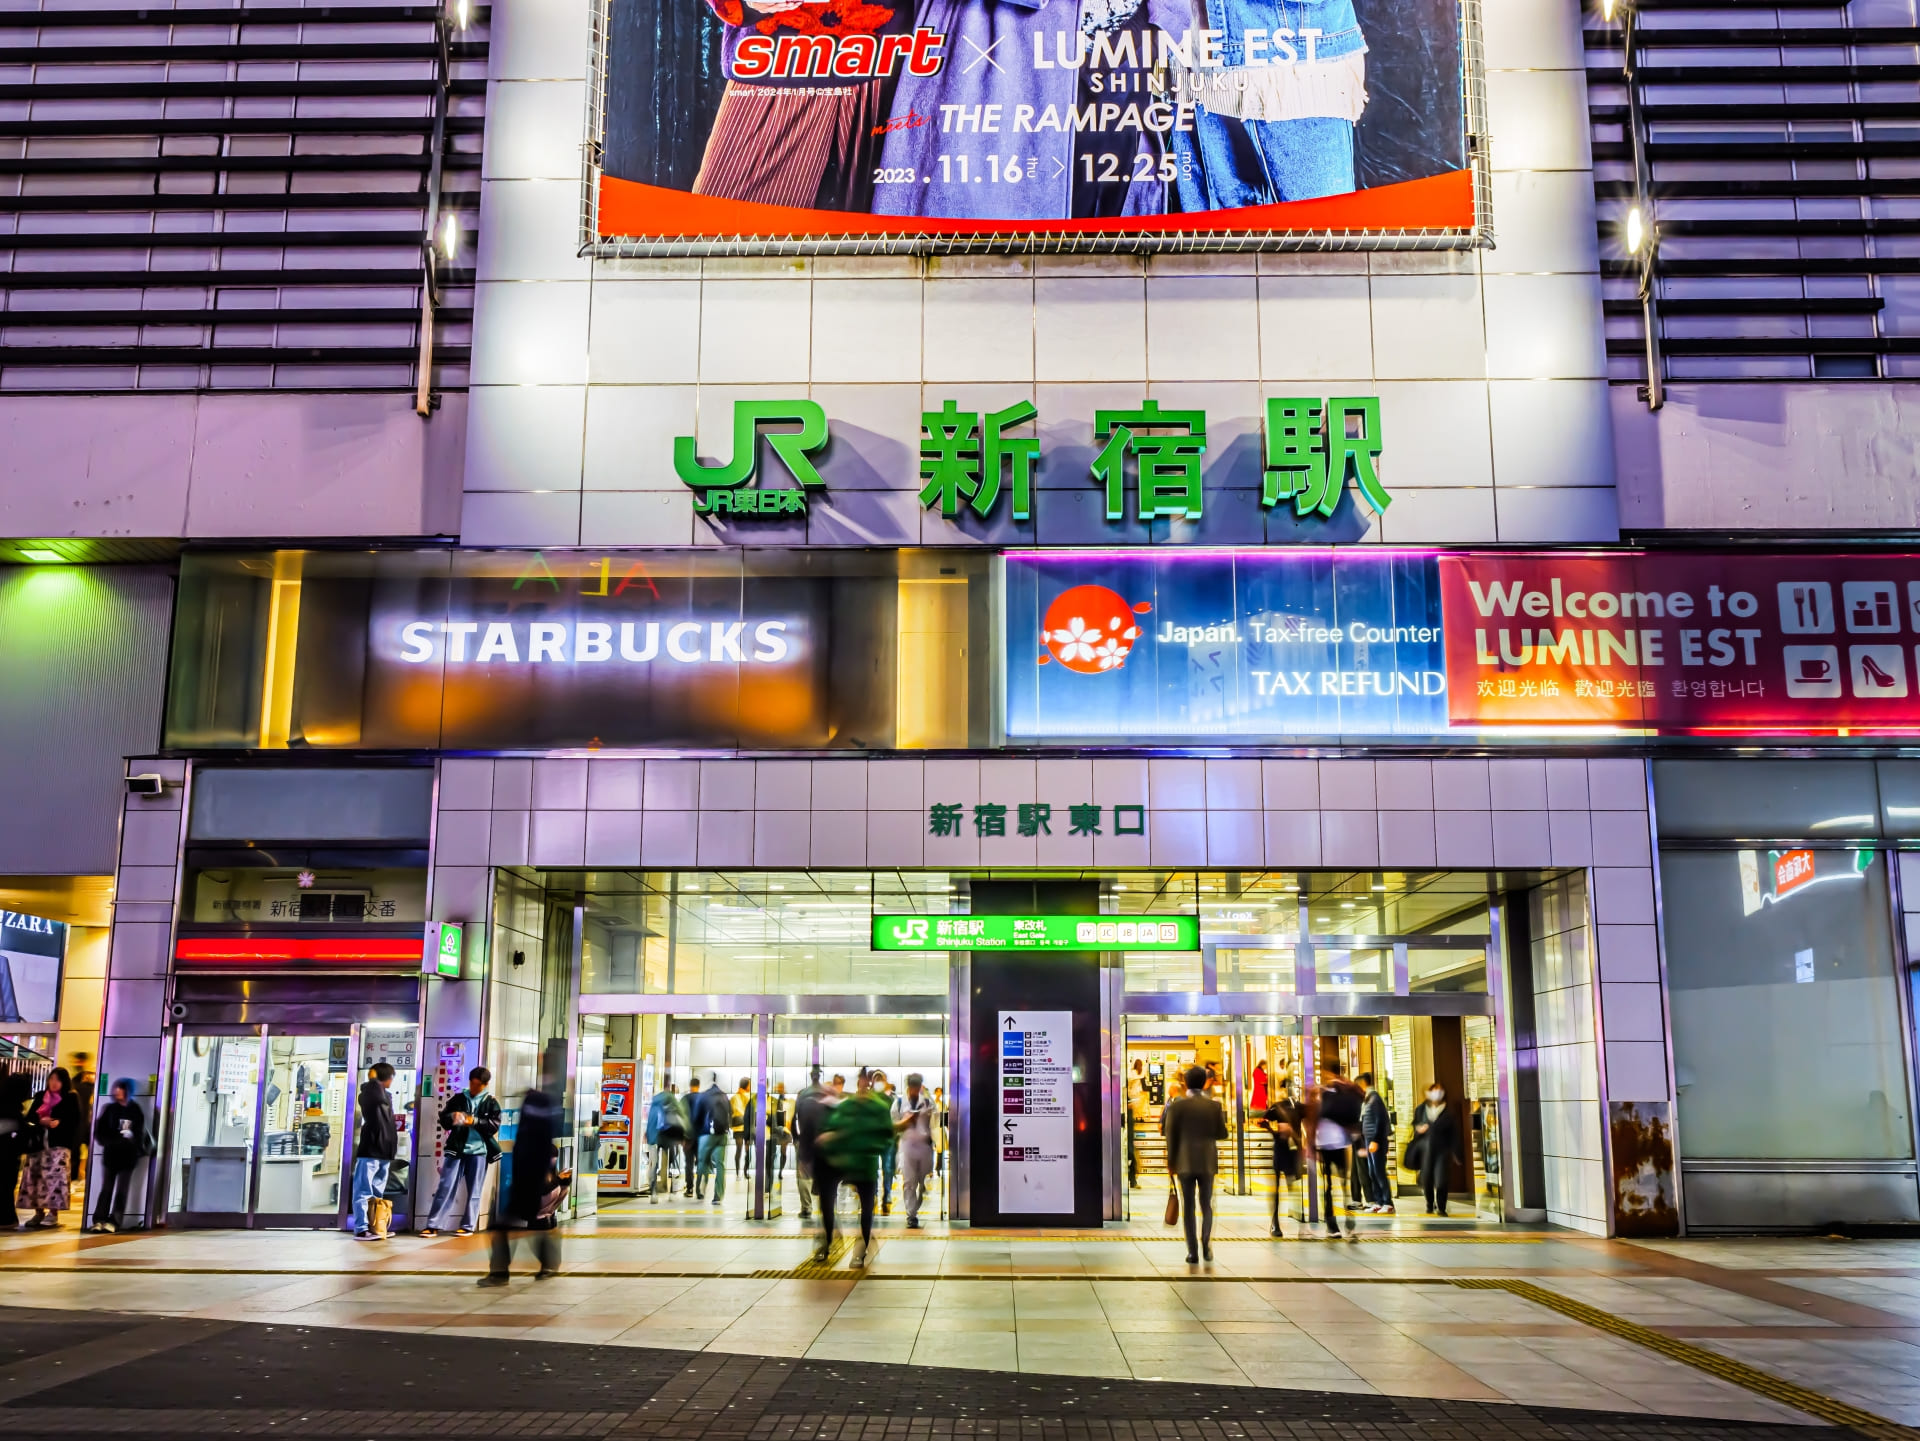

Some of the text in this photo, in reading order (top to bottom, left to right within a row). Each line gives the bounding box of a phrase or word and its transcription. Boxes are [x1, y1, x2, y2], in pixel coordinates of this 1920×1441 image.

[732, 26, 945, 78] smart
[1033, 30, 1225, 69] LUMINE
[1244, 28, 1323, 66] EST
[729, 89, 755, 97] smart
[1090, 72, 1250, 93] SHINJUKU
[871, 109, 931, 137] meets
[939, 102, 1195, 133] THE RAMPAGE
[938, 154, 1023, 184] 11.16
[1080, 153, 1179, 183] 12.25
[673, 400, 828, 490] JR
[917, 396, 1394, 521] 新宿駅
[692, 488, 807, 516] JR東日本
[1468, 577, 1759, 618] Welcome to
[399, 620, 789, 663] STARBUCKS
[1157, 621, 1441, 648] Japan. Tax-free Counter
[1475, 628, 1762, 667] LUMINE EST
[1251, 671, 1447, 695] TAX REFUND
[1476, 679, 1656, 698] 欢迎光临 歡迎光臨
[1671, 679, 1765, 698] 환영합니다
[929, 803, 1145, 837] 新宿駅東口
[4, 911, 54, 935] ZARA
[893, 919, 929, 939] JR
[936, 919, 985, 936] 新宿駅
[936, 937, 974, 948] Shinjuku
[976, 937, 1007, 946] Station
[396, 1056, 411, 1065] 68
